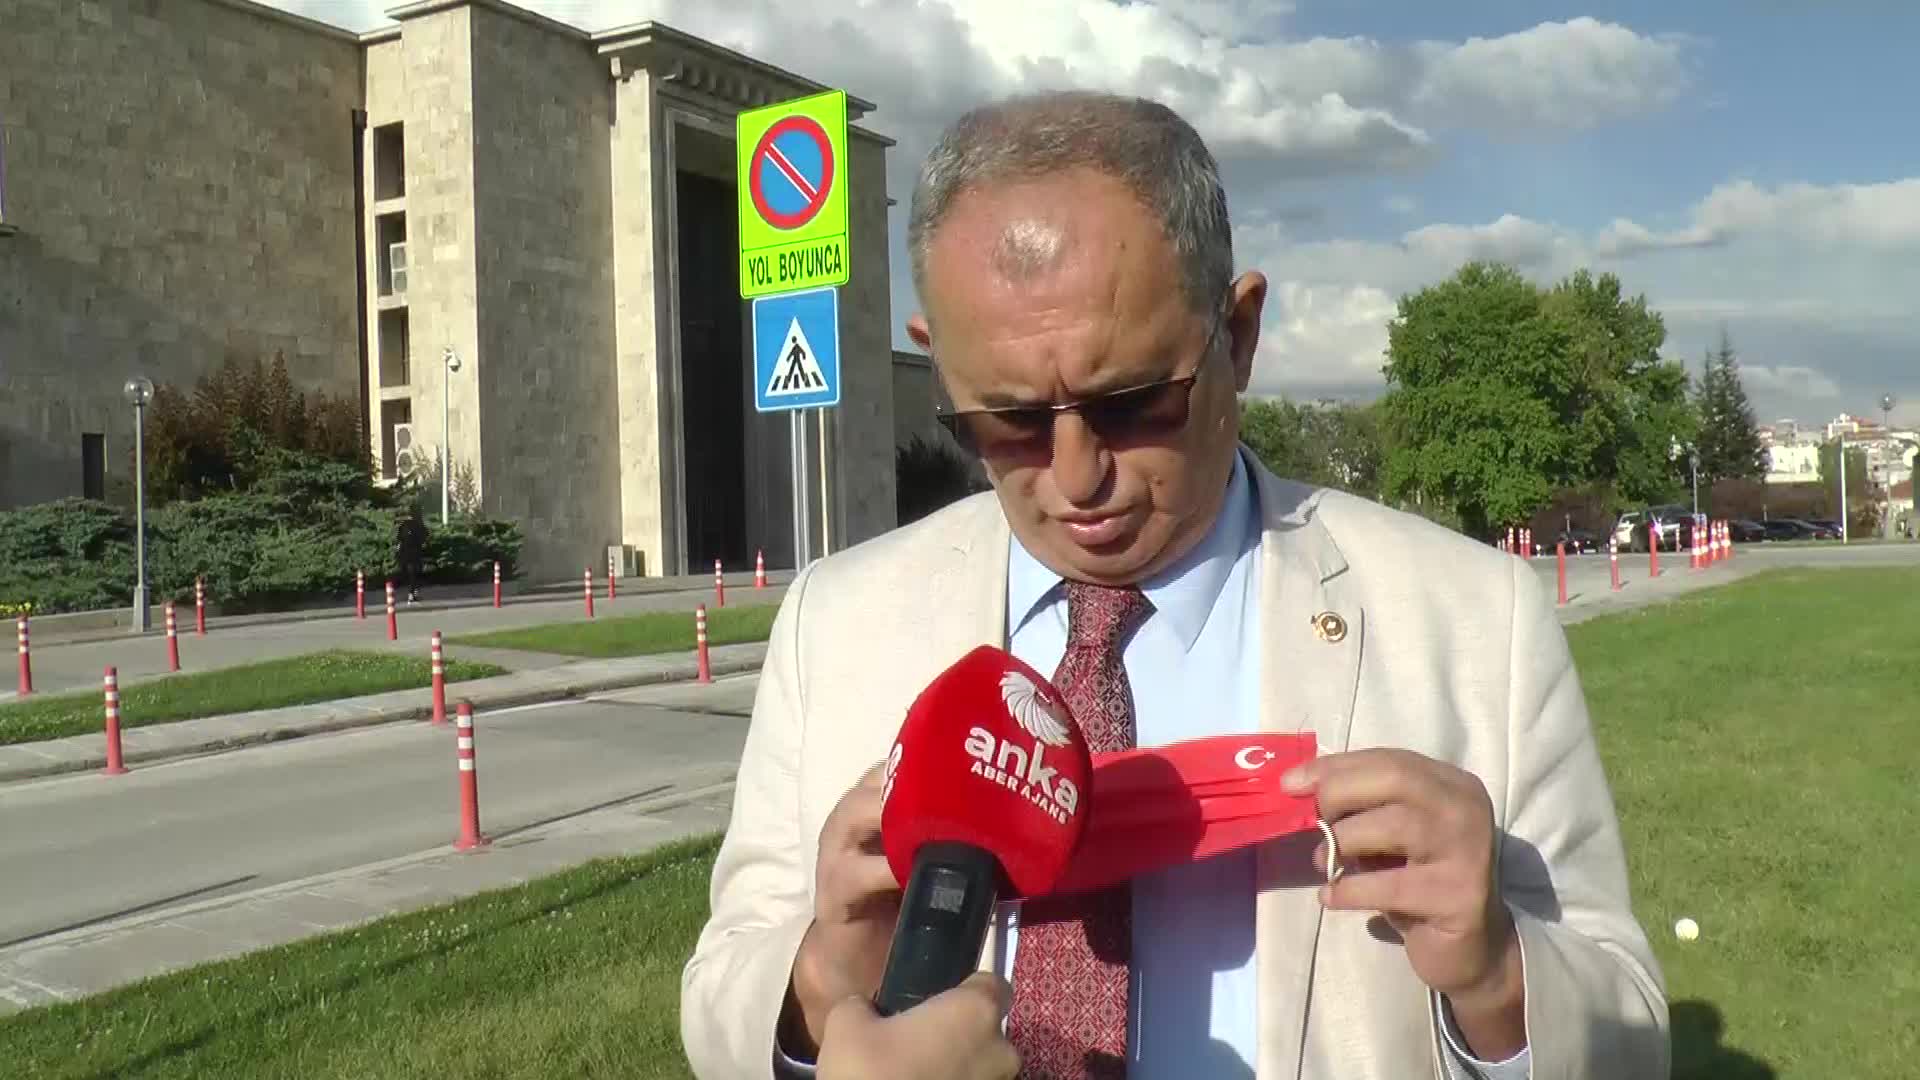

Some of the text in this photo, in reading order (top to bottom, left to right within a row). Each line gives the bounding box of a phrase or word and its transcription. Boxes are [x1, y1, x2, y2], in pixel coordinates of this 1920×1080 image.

[749, 244, 841, 287] YOL BOYUNCA
[964, 727, 1078, 816] anka
[970, 761, 1018, 793] ABER
